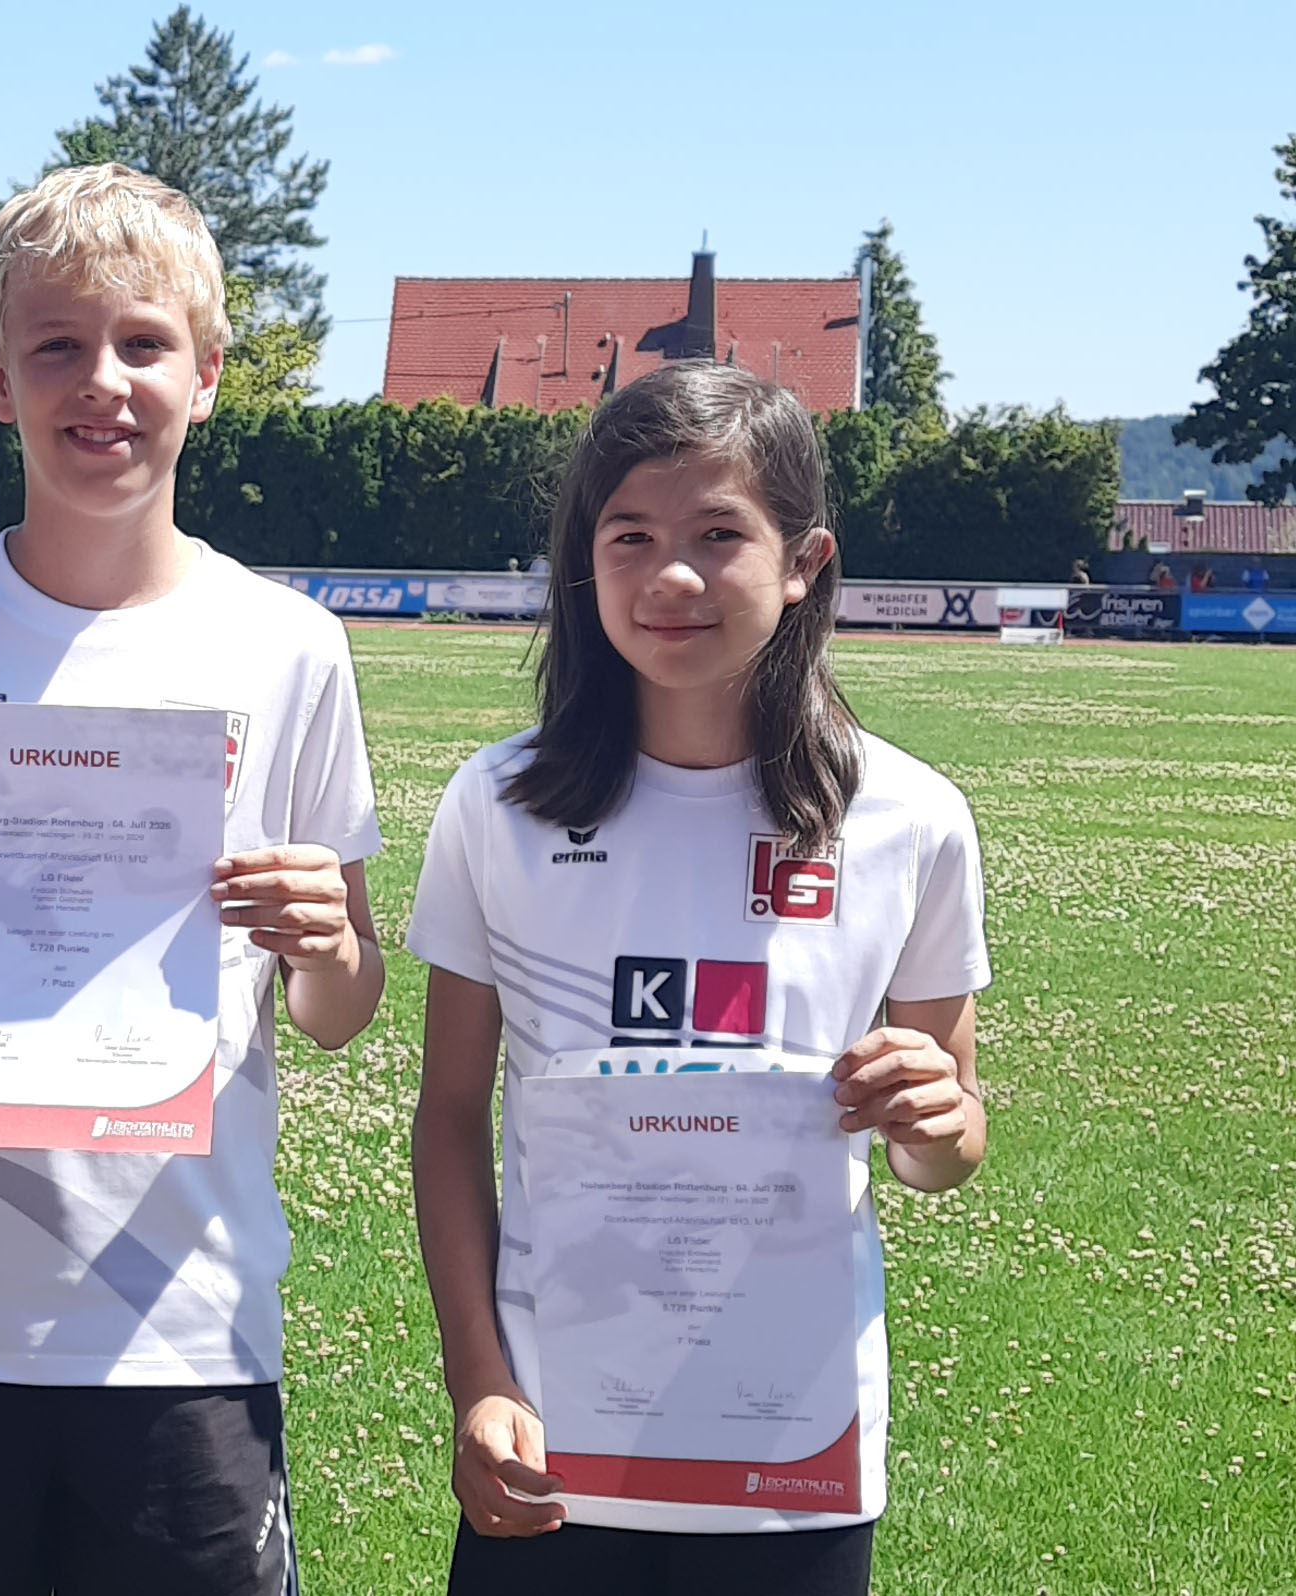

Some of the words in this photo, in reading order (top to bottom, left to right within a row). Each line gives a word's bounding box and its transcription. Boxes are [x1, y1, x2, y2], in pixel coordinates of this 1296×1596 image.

[862, 593, 928, 604] WINGHOFER
[9, 747, 121, 769] URKUNDE
[551, 849, 609, 865] erima
[630, 969, 673, 1020] K
[629, 1115, 741, 1133] URKUNDE
